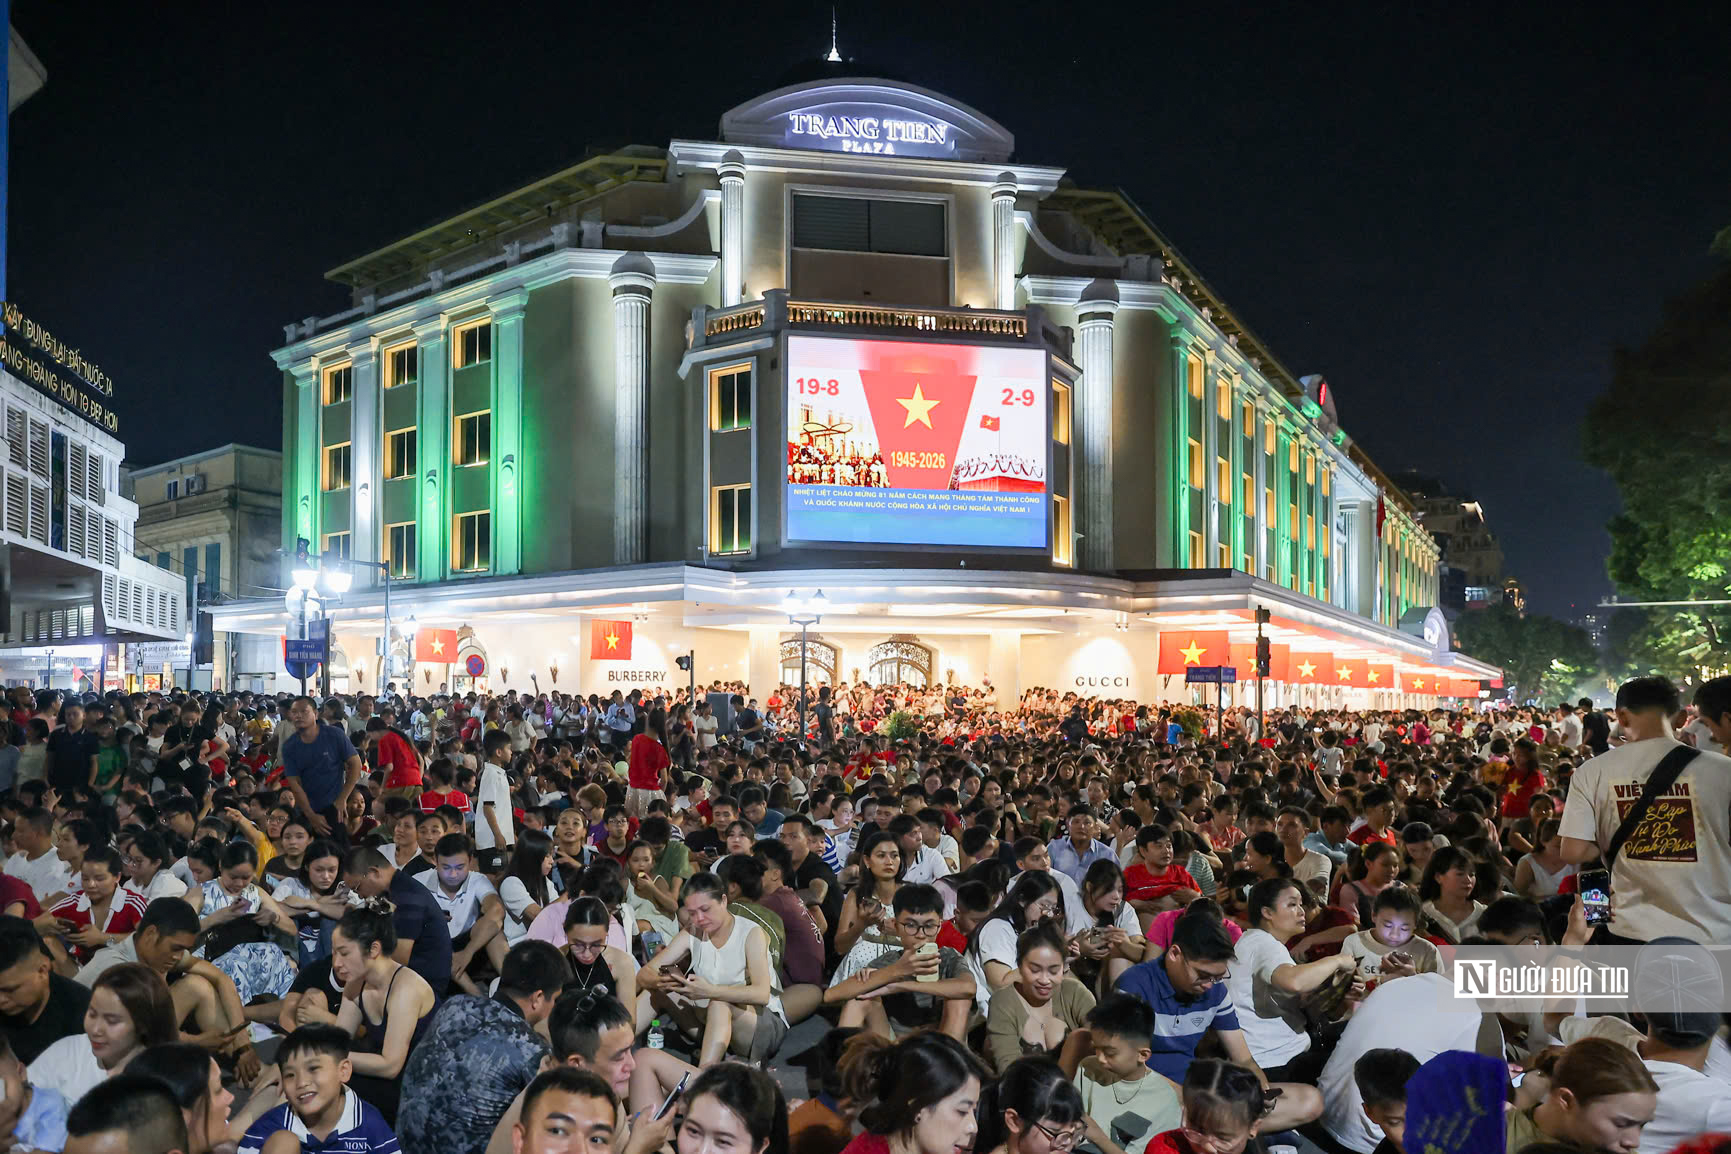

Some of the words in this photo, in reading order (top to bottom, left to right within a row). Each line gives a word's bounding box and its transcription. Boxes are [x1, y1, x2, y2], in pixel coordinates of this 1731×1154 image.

[789, 112, 880, 139] TRANG
[883, 119, 948, 144] TIEN
[841, 139, 896, 155] PLAZA
[105, 376, 114, 398] TA
[796, 377, 840, 396] 19-8
[79, 392, 89, 412] TO
[1001, 388, 1035, 407] 2-9
[891, 451, 946, 469] 1945-2026
[608, 671, 667, 682] BURBERRY
[1075, 676, 1129, 687] GUCCI
